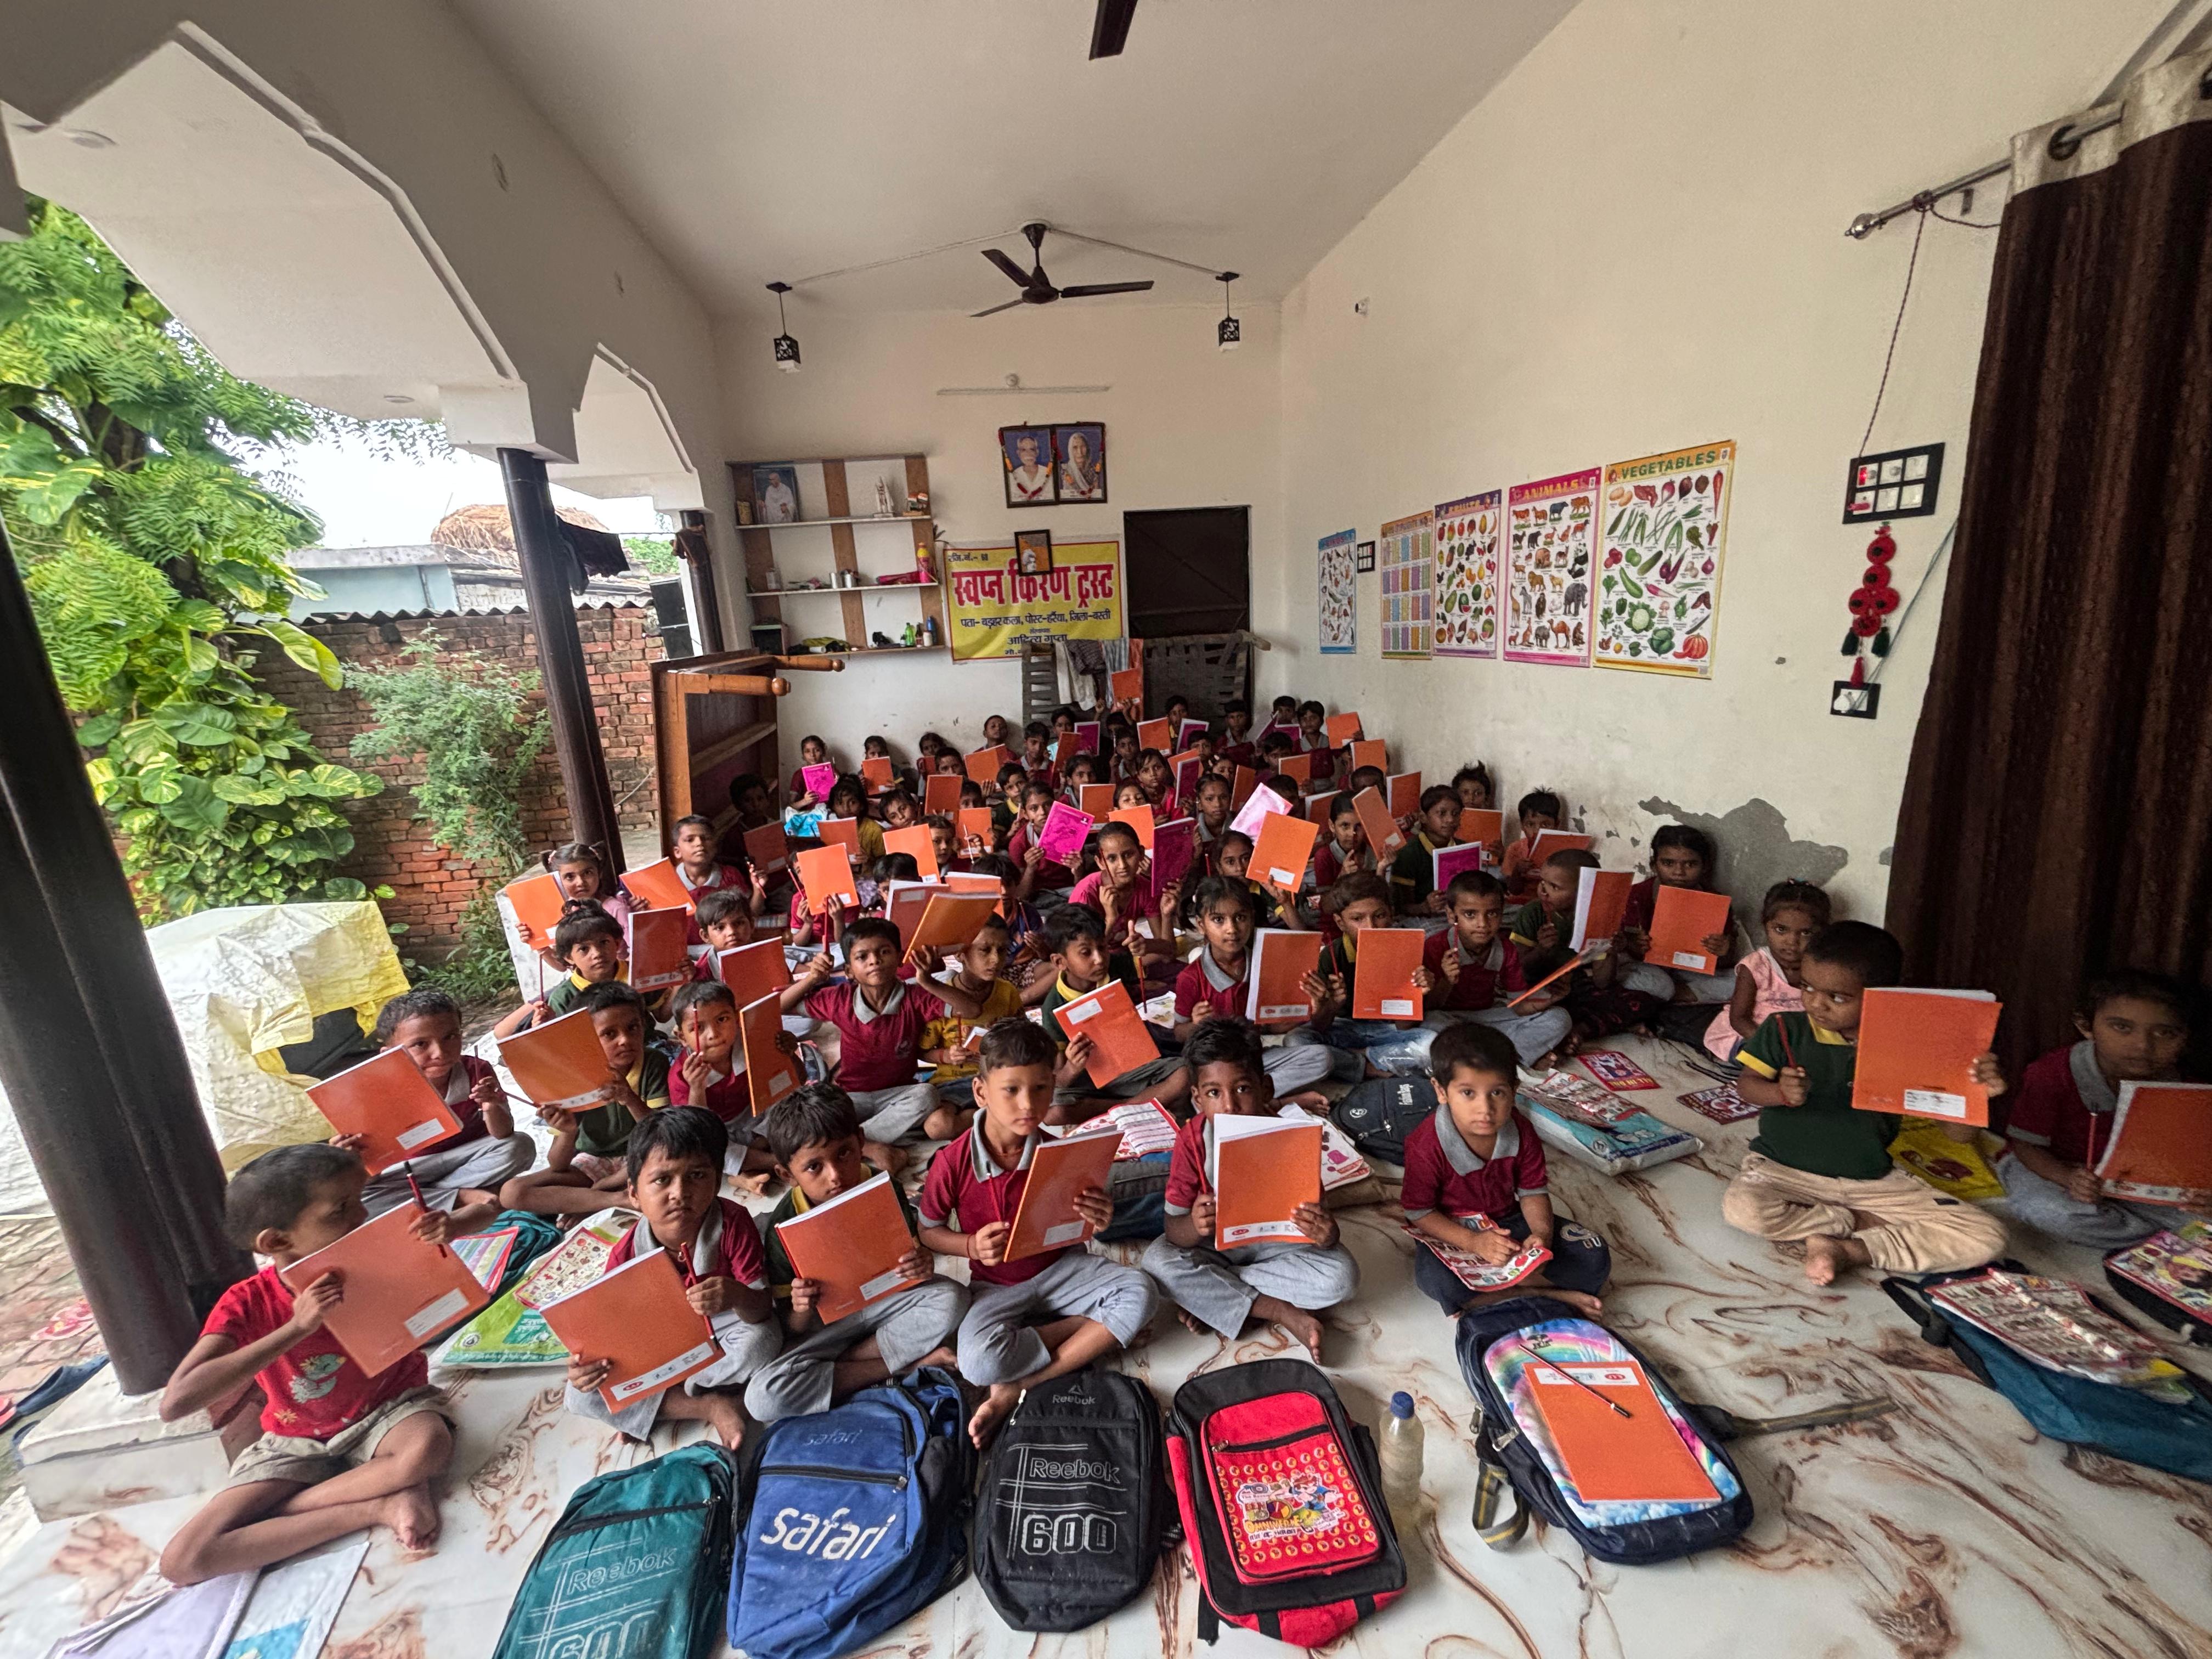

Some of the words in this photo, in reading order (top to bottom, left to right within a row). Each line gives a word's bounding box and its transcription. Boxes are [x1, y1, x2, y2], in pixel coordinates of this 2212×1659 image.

[1622, 450, 1716, 479] VEGETABLES
[1523, 479, 1579, 500] ANIMALS
[952, 569, 1005, 606] स्वप्न
[1075, 564, 1114, 608] ट्रस्ट
[1053, 1395, 1096, 1405] Reebok
[803, 1429, 863, 1447] safari
[1030, 1457, 1120, 1484] Reebok
[760, 1508, 896, 1561] safari
[1021, 1513, 1116, 1556] 600
[567, 1547, 678, 1595] Reebok
